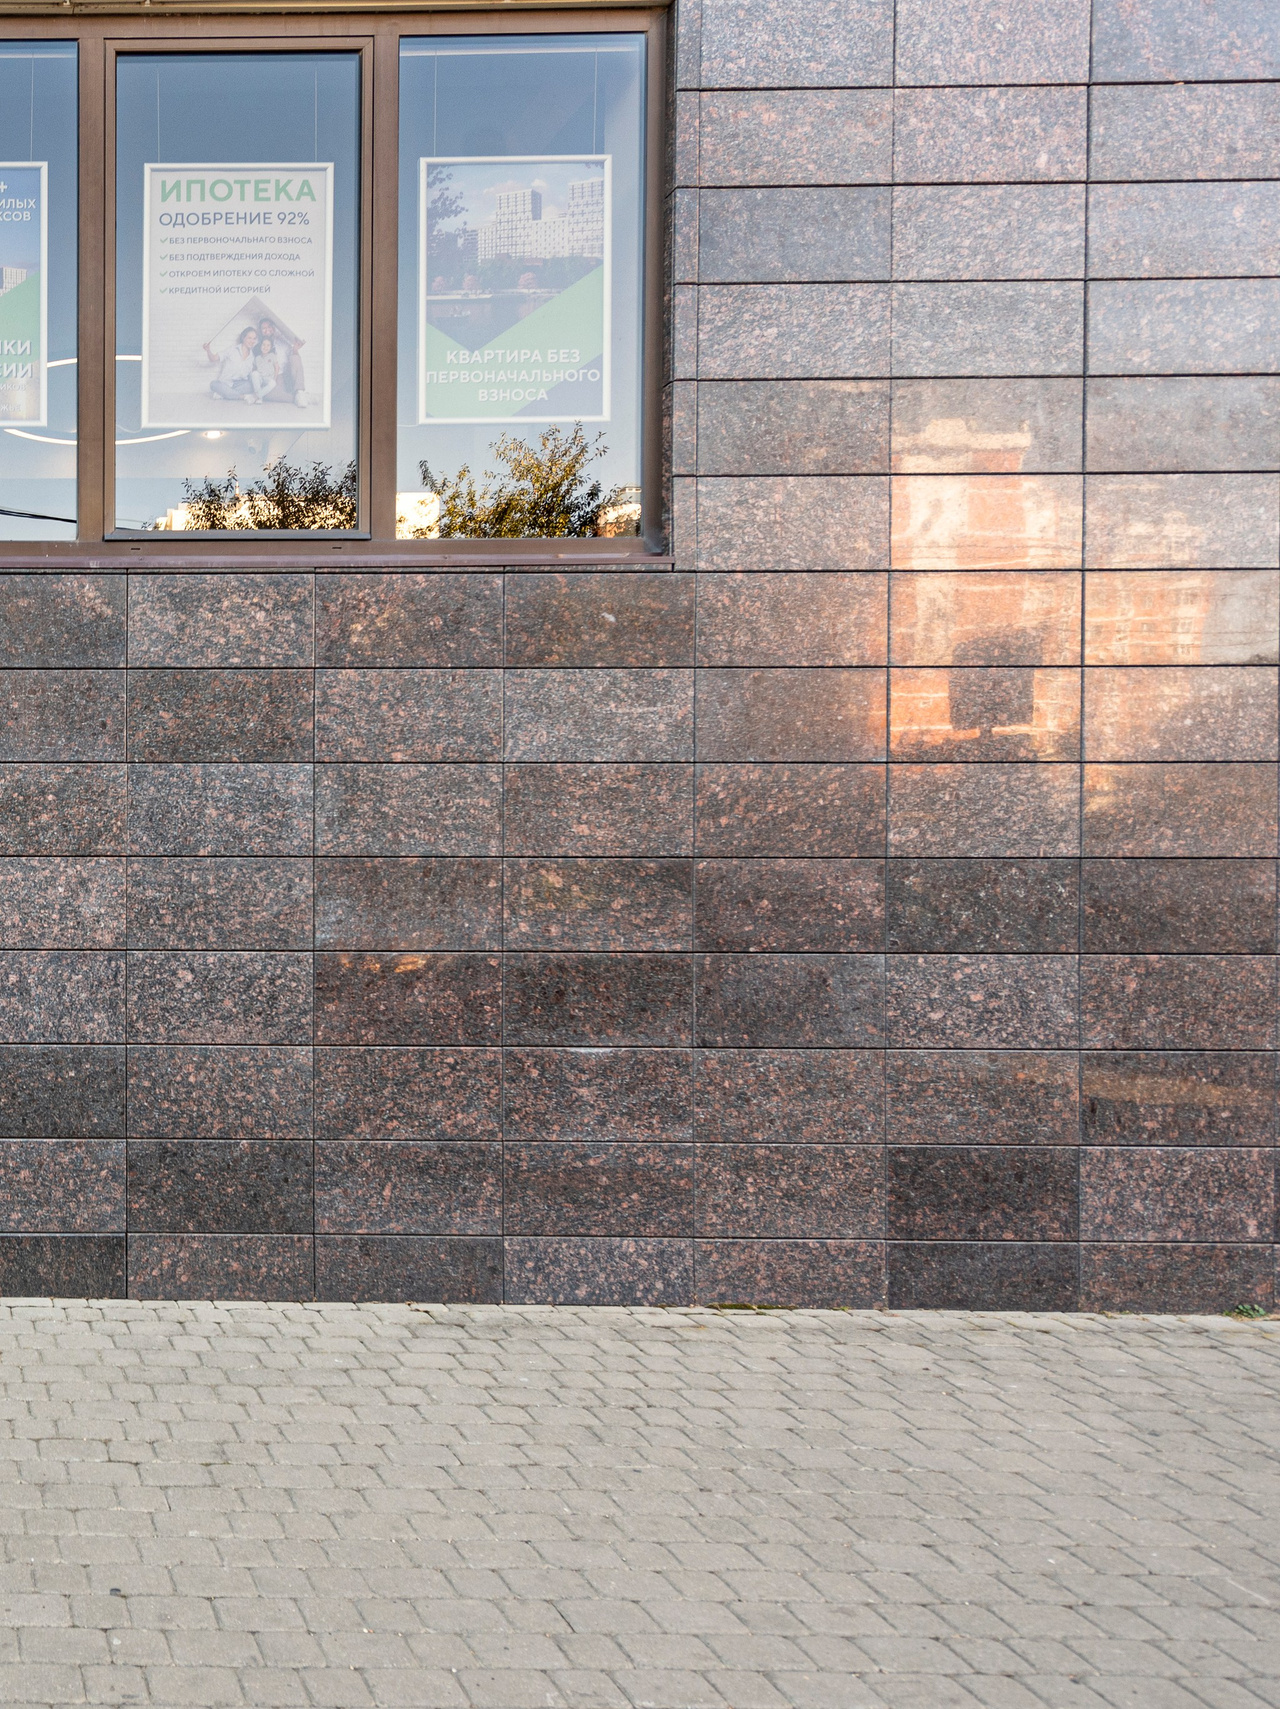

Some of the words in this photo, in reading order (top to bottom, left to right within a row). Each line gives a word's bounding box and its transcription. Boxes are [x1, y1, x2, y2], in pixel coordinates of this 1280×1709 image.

[161, 179, 317, 203] ИПОТЕКА
[159, 212, 273, 228] ОДОБРЕНИЕ
[278, 212, 310, 225] 92%
[187, 253, 263, 262] ПОДТВЕРЖДЕНИЯ
[169, 270, 211, 278] ОТКРОЕМ
[269, 269, 315, 278] СЛОЖНОЙ
[169, 286, 221, 295] КРЕДИТНОЙ
[224, 285, 271, 294] ИСТОРИЕЙ
[447, 350, 543, 364] КВАРТИРА
[548, 349, 580, 363] БЕЗ
[427, 369, 600, 384] ПЕРВОНАЧАЛЬНОГО
[479, 389, 548, 402] ВЗНОСА
